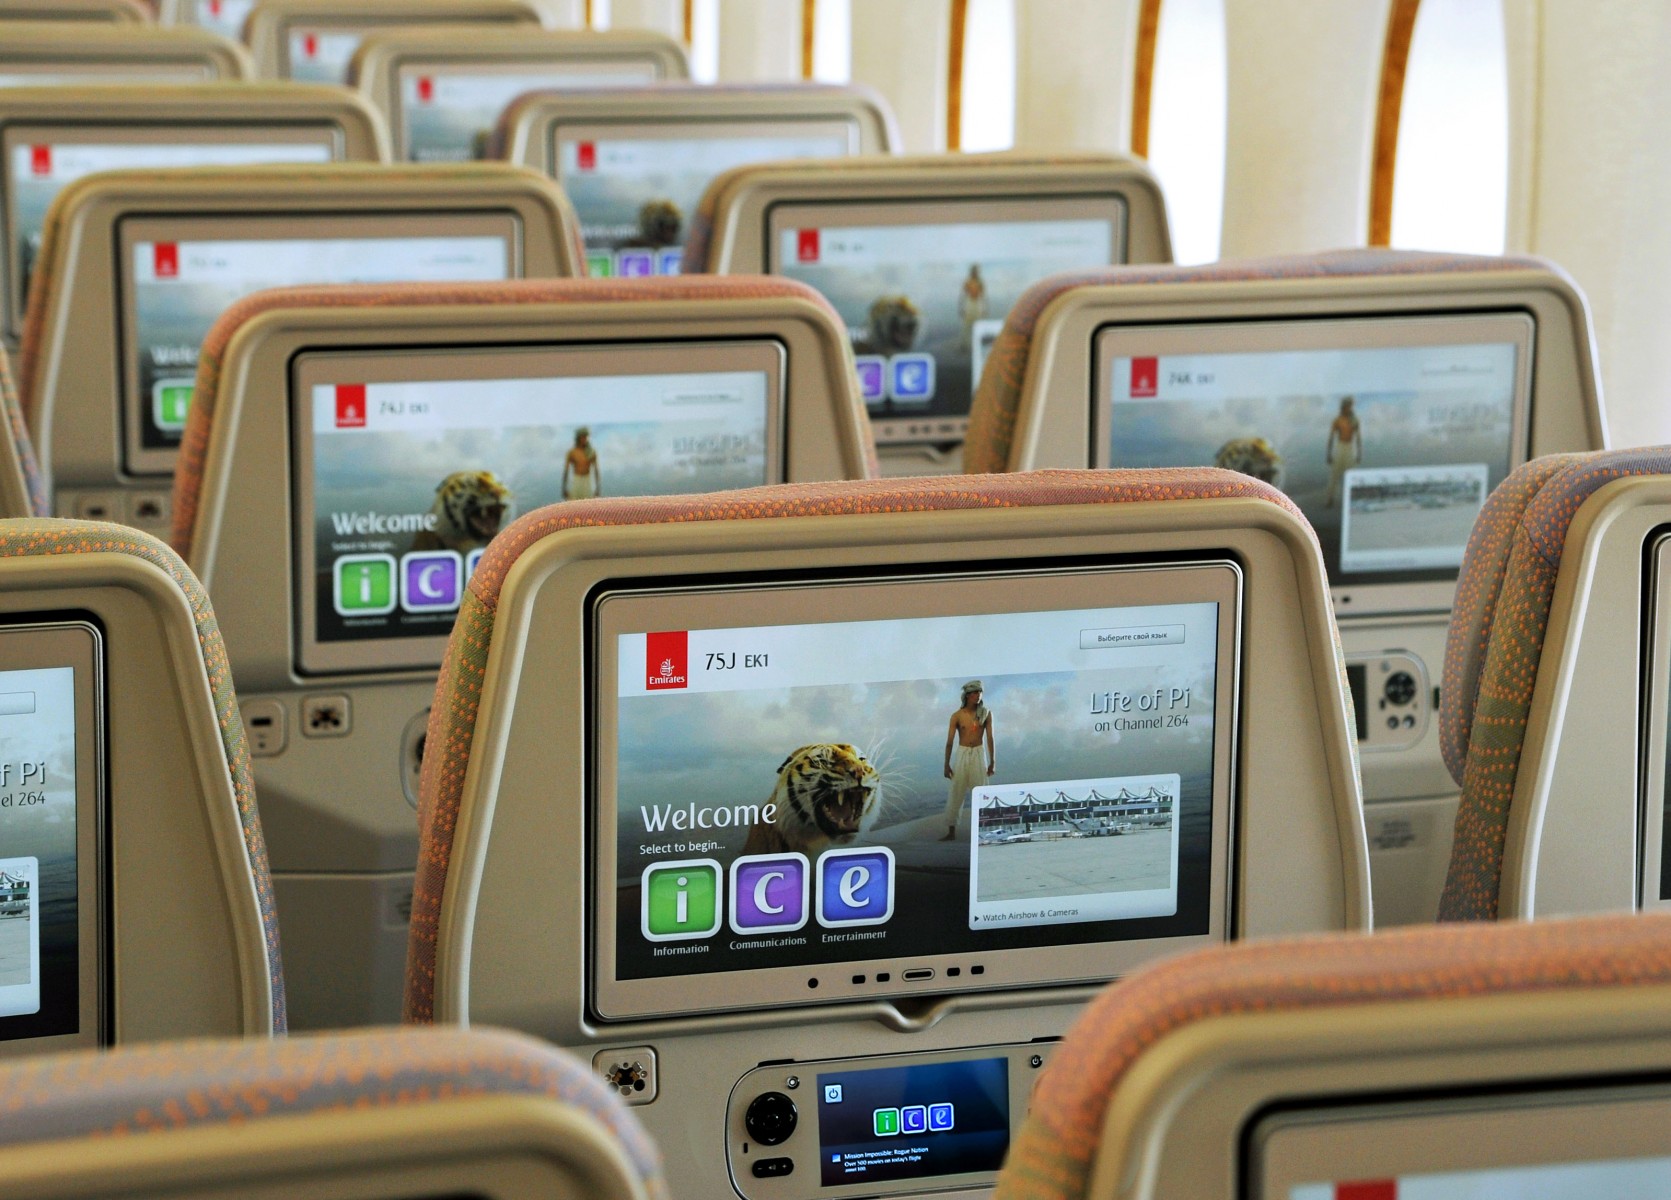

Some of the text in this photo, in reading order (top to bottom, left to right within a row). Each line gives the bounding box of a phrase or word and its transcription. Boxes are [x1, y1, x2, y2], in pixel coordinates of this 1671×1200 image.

[331, 511, 438, 535] Welcome
[1097, 632, 1168, 643] Выберите свой язык
[705, 652, 769, 670] 75J EK1
[649, 675, 685, 685] Emirates
[1090, 687, 1190, 714] Life of Pi
[1094, 714, 1189, 732] on Channel 264
[20, 761, 46, 787] Pi
[18, 790, 46, 806] 264
[640, 802, 777, 832] Welcome
[640, 840, 726, 855] Select to begin...
[676, 876, 688, 924] i
[982, 913, 1007, 922] Watch
[1008, 911, 1038, 920] Airshow
[1047, 909, 1079, 918] Cameras
[653, 930, 887, 957] Information Communications Entertainment
